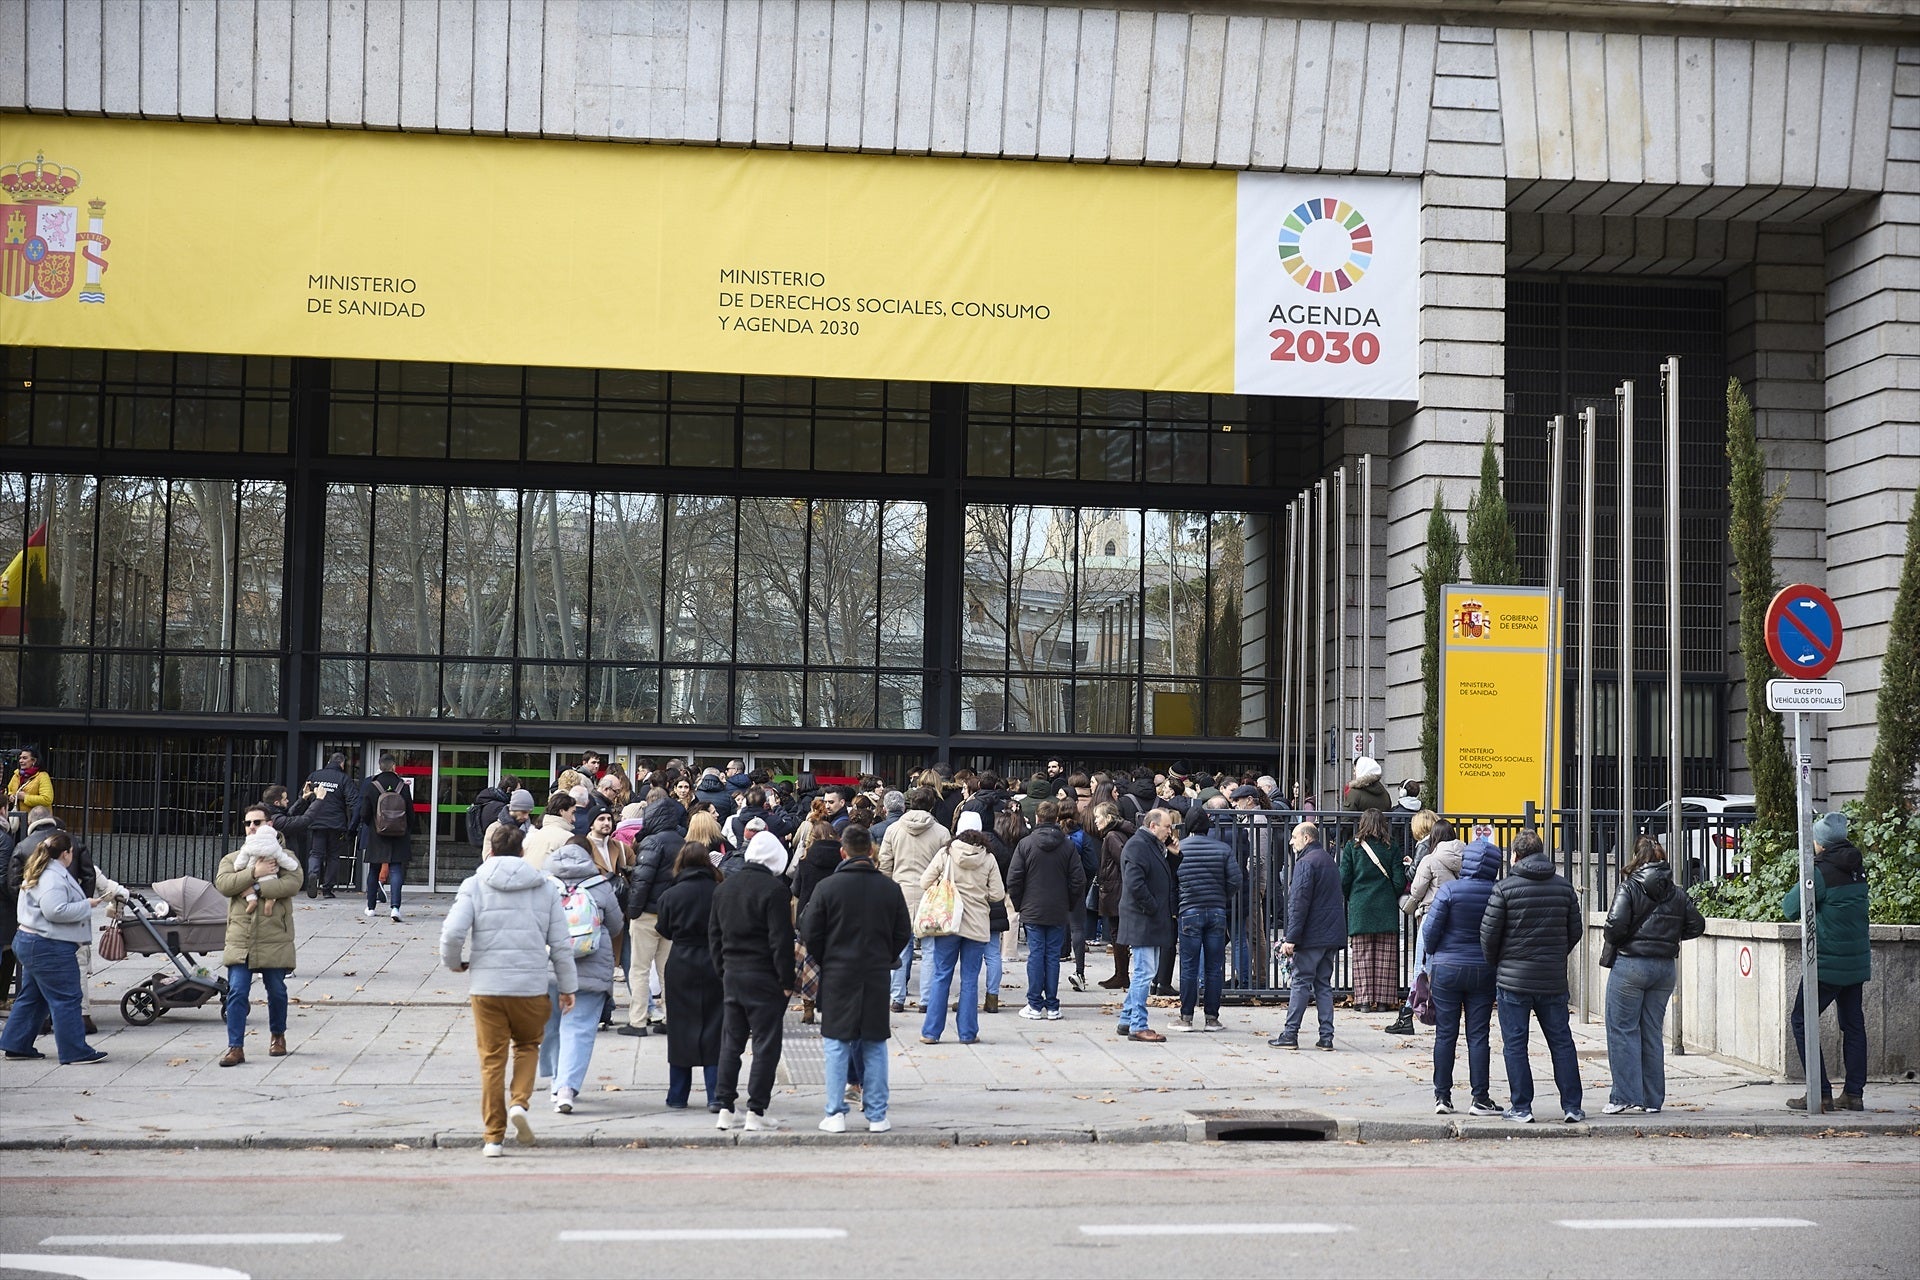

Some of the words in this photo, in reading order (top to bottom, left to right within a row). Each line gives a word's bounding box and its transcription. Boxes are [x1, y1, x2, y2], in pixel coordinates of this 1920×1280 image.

[308, 275, 417, 294] MINISTERIO
[720, 269, 825, 287] MINISTERIO
[307, 298, 333, 314] DE
[338, 299, 426, 318] SANIDAD
[719, 292, 744, 307] DE
[750, 294, 851, 312] DERECHOS
[856, 297, 947, 318] SOCIALES,
[951, 301, 1051, 320] CONSUMO
[718, 315, 731, 331] Y
[733, 317, 814, 334] AGENDA
[820, 319, 860, 336] 2030
[1268, 304, 1381, 328] AGENDA
[1268, 328, 1381, 365] 2030
[1499, 614, 1539, 622] GOBIERNO
[1499, 622, 1510, 630] DE
[1511, 621, 1539, 630] ESPAÑA
[1470, 689, 1498, 697] SANIDAD
[1774, 696, 1810, 704] VEHÍCULOS
[1810, 697, 1843, 705] OFICIALES
